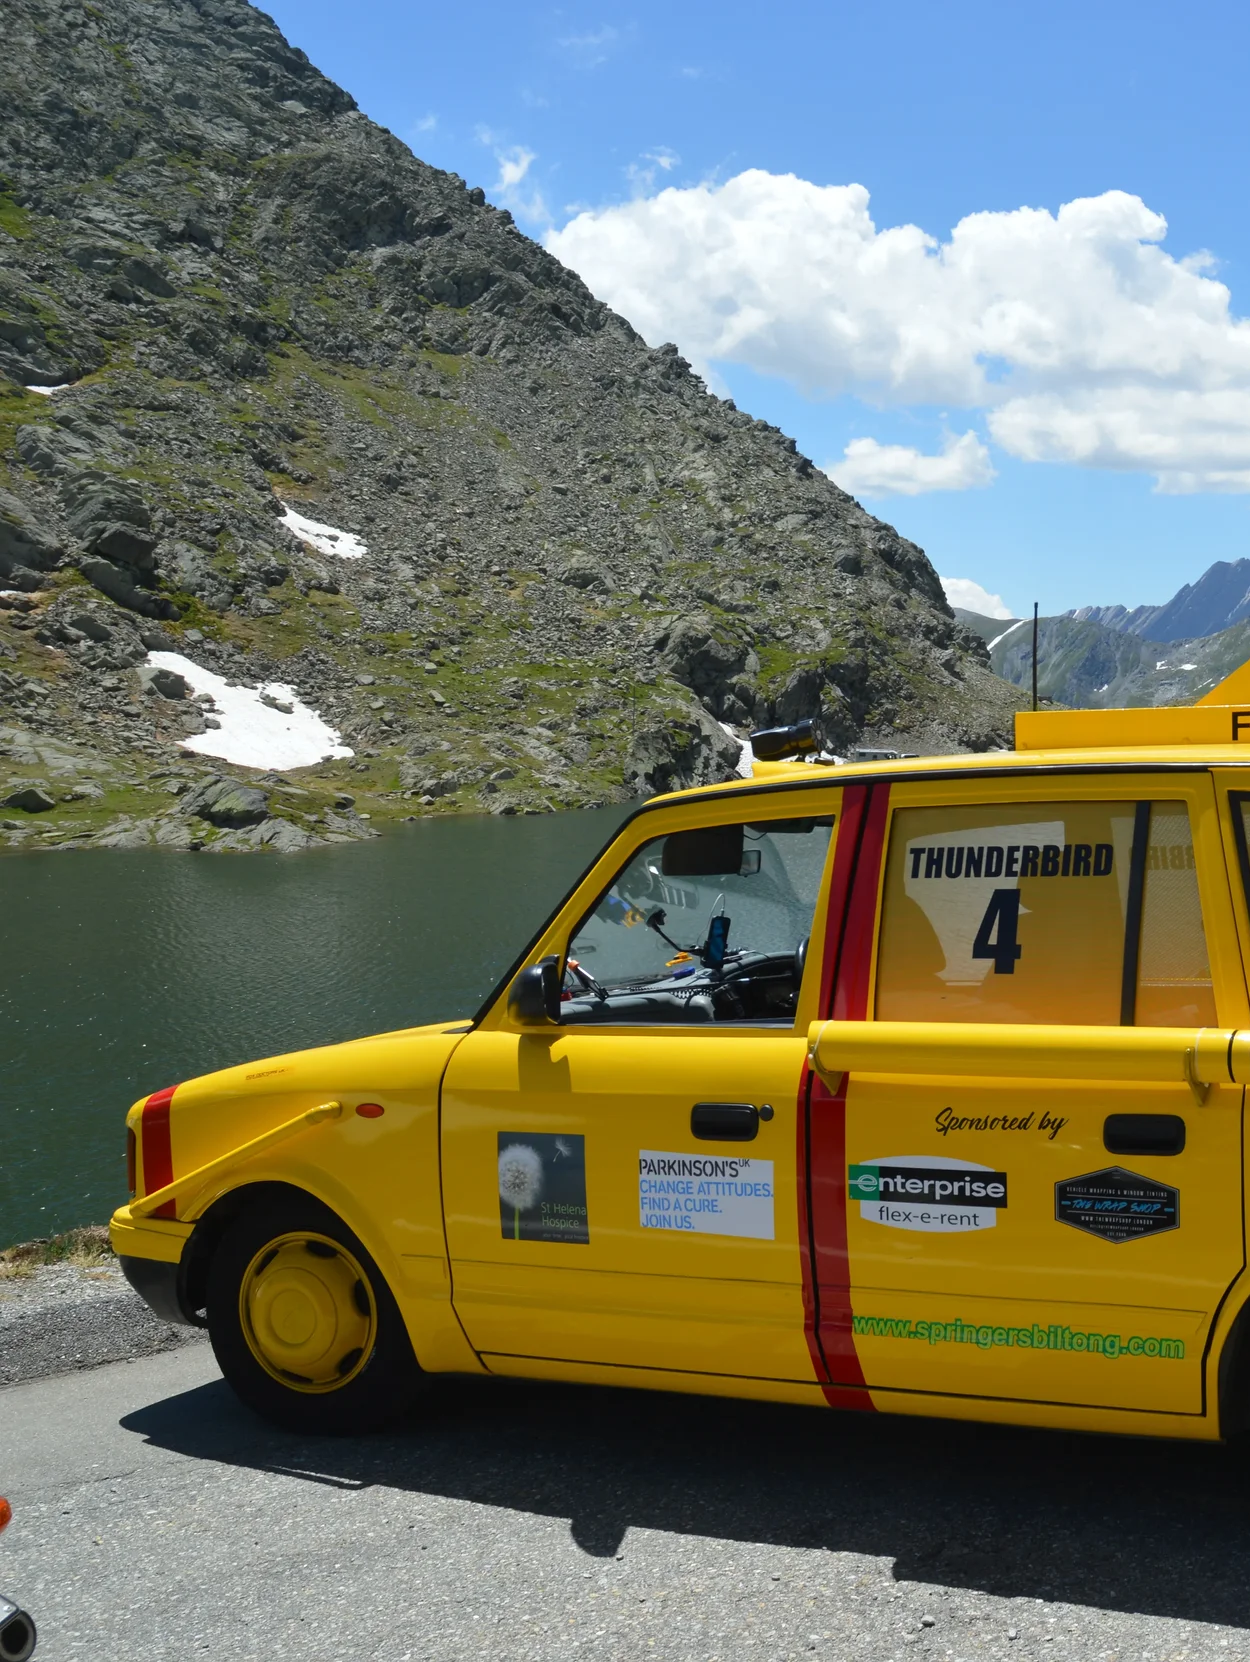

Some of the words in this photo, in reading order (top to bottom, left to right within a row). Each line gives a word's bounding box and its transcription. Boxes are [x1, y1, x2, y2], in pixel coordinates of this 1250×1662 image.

[909, 843, 1114, 880] THUNDERBIRD
[972, 888, 1022, 976] 4
[935, 1107, 1035, 1136] Sponsored
[1037, 1111, 1069, 1140] by
[639, 1158, 739, 1178] PARKINSON'S
[640, 1179, 694, 1195] CHANGE
[697, 1181, 774, 1198] ATTITUDES.
[848, 1174, 1006, 1200] enterprise
[540, 1202, 551, 1214] St
[553, 1203, 587, 1216] Helena
[640, 1196, 671, 1211] FIND
[672, 1198, 683, 1212] A
[684, 1198, 723, 1214] CURE.
[1072, 1199, 1093, 1210] THE
[1094, 1200, 1128, 1212] WRAP
[1129, 1202, 1162, 1214] SHOP
[541, 1215, 580, 1230] Hospice
[641, 1213, 673, 1229] JOIN
[674, 1215, 696, 1230] US.
[878, 1205, 980, 1227] flex-e-rent
[852, 1315, 1185, 1360] www.springersbiltong.com
